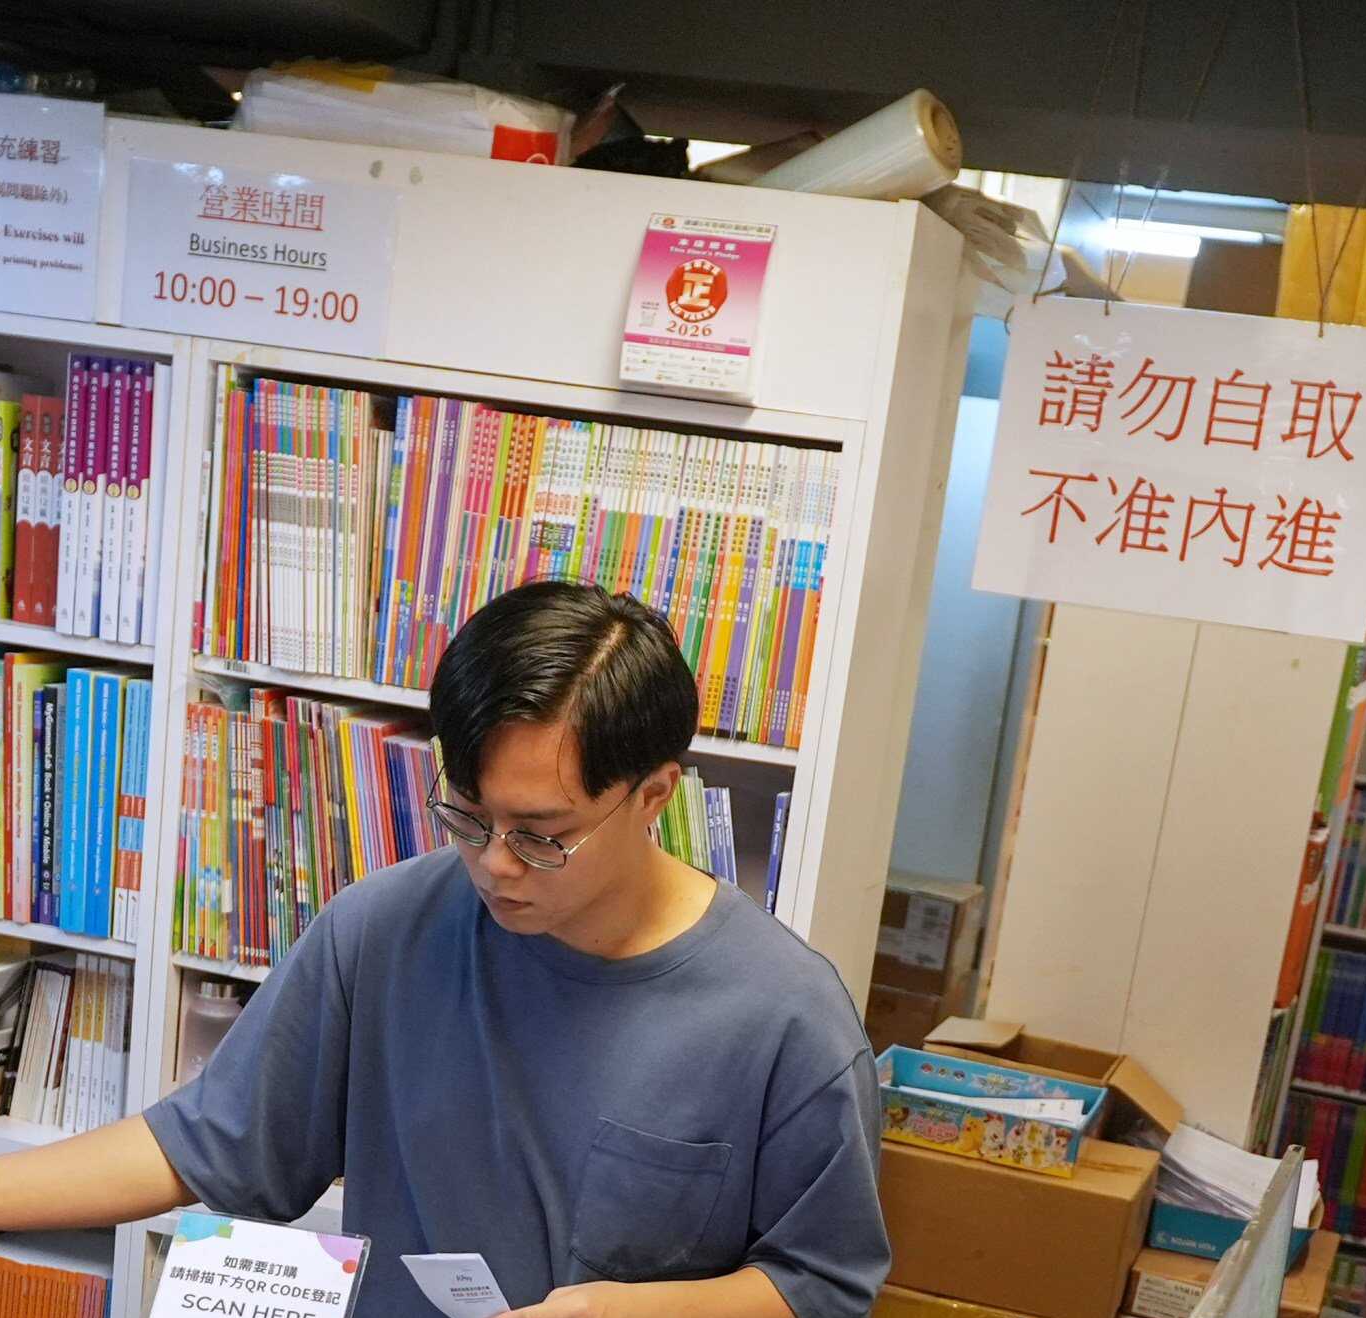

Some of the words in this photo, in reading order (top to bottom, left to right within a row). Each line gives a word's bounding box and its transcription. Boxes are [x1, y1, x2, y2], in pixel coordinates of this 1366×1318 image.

[200, 184, 324, 230] 營業時間
[4, 224, 59, 241] Exercises
[62, 231, 84, 244] will
[189, 233, 268, 259] Business
[274, 243, 327, 266] Hours
[154, 271, 236, 308] 10:00
[274, 285, 359, 323] 19:00
[666, 320, 713, 337] 2026
[1038, 350, 1364, 462] 請勿自取
[1020, 468, 1343, 578] 不准內進
[44, 702, 53, 770] MyGrammarLab
[44, 800, 52, 829] Online
[43, 835, 51, 864] Mobile
[223, 1255, 298, 1279] 如需要訂購
[170, 1266, 267, 1293] 請掃描下方QR
[270, 1283, 341, 1305] CODE登記
[181, 1293, 246, 1317] SCAN
